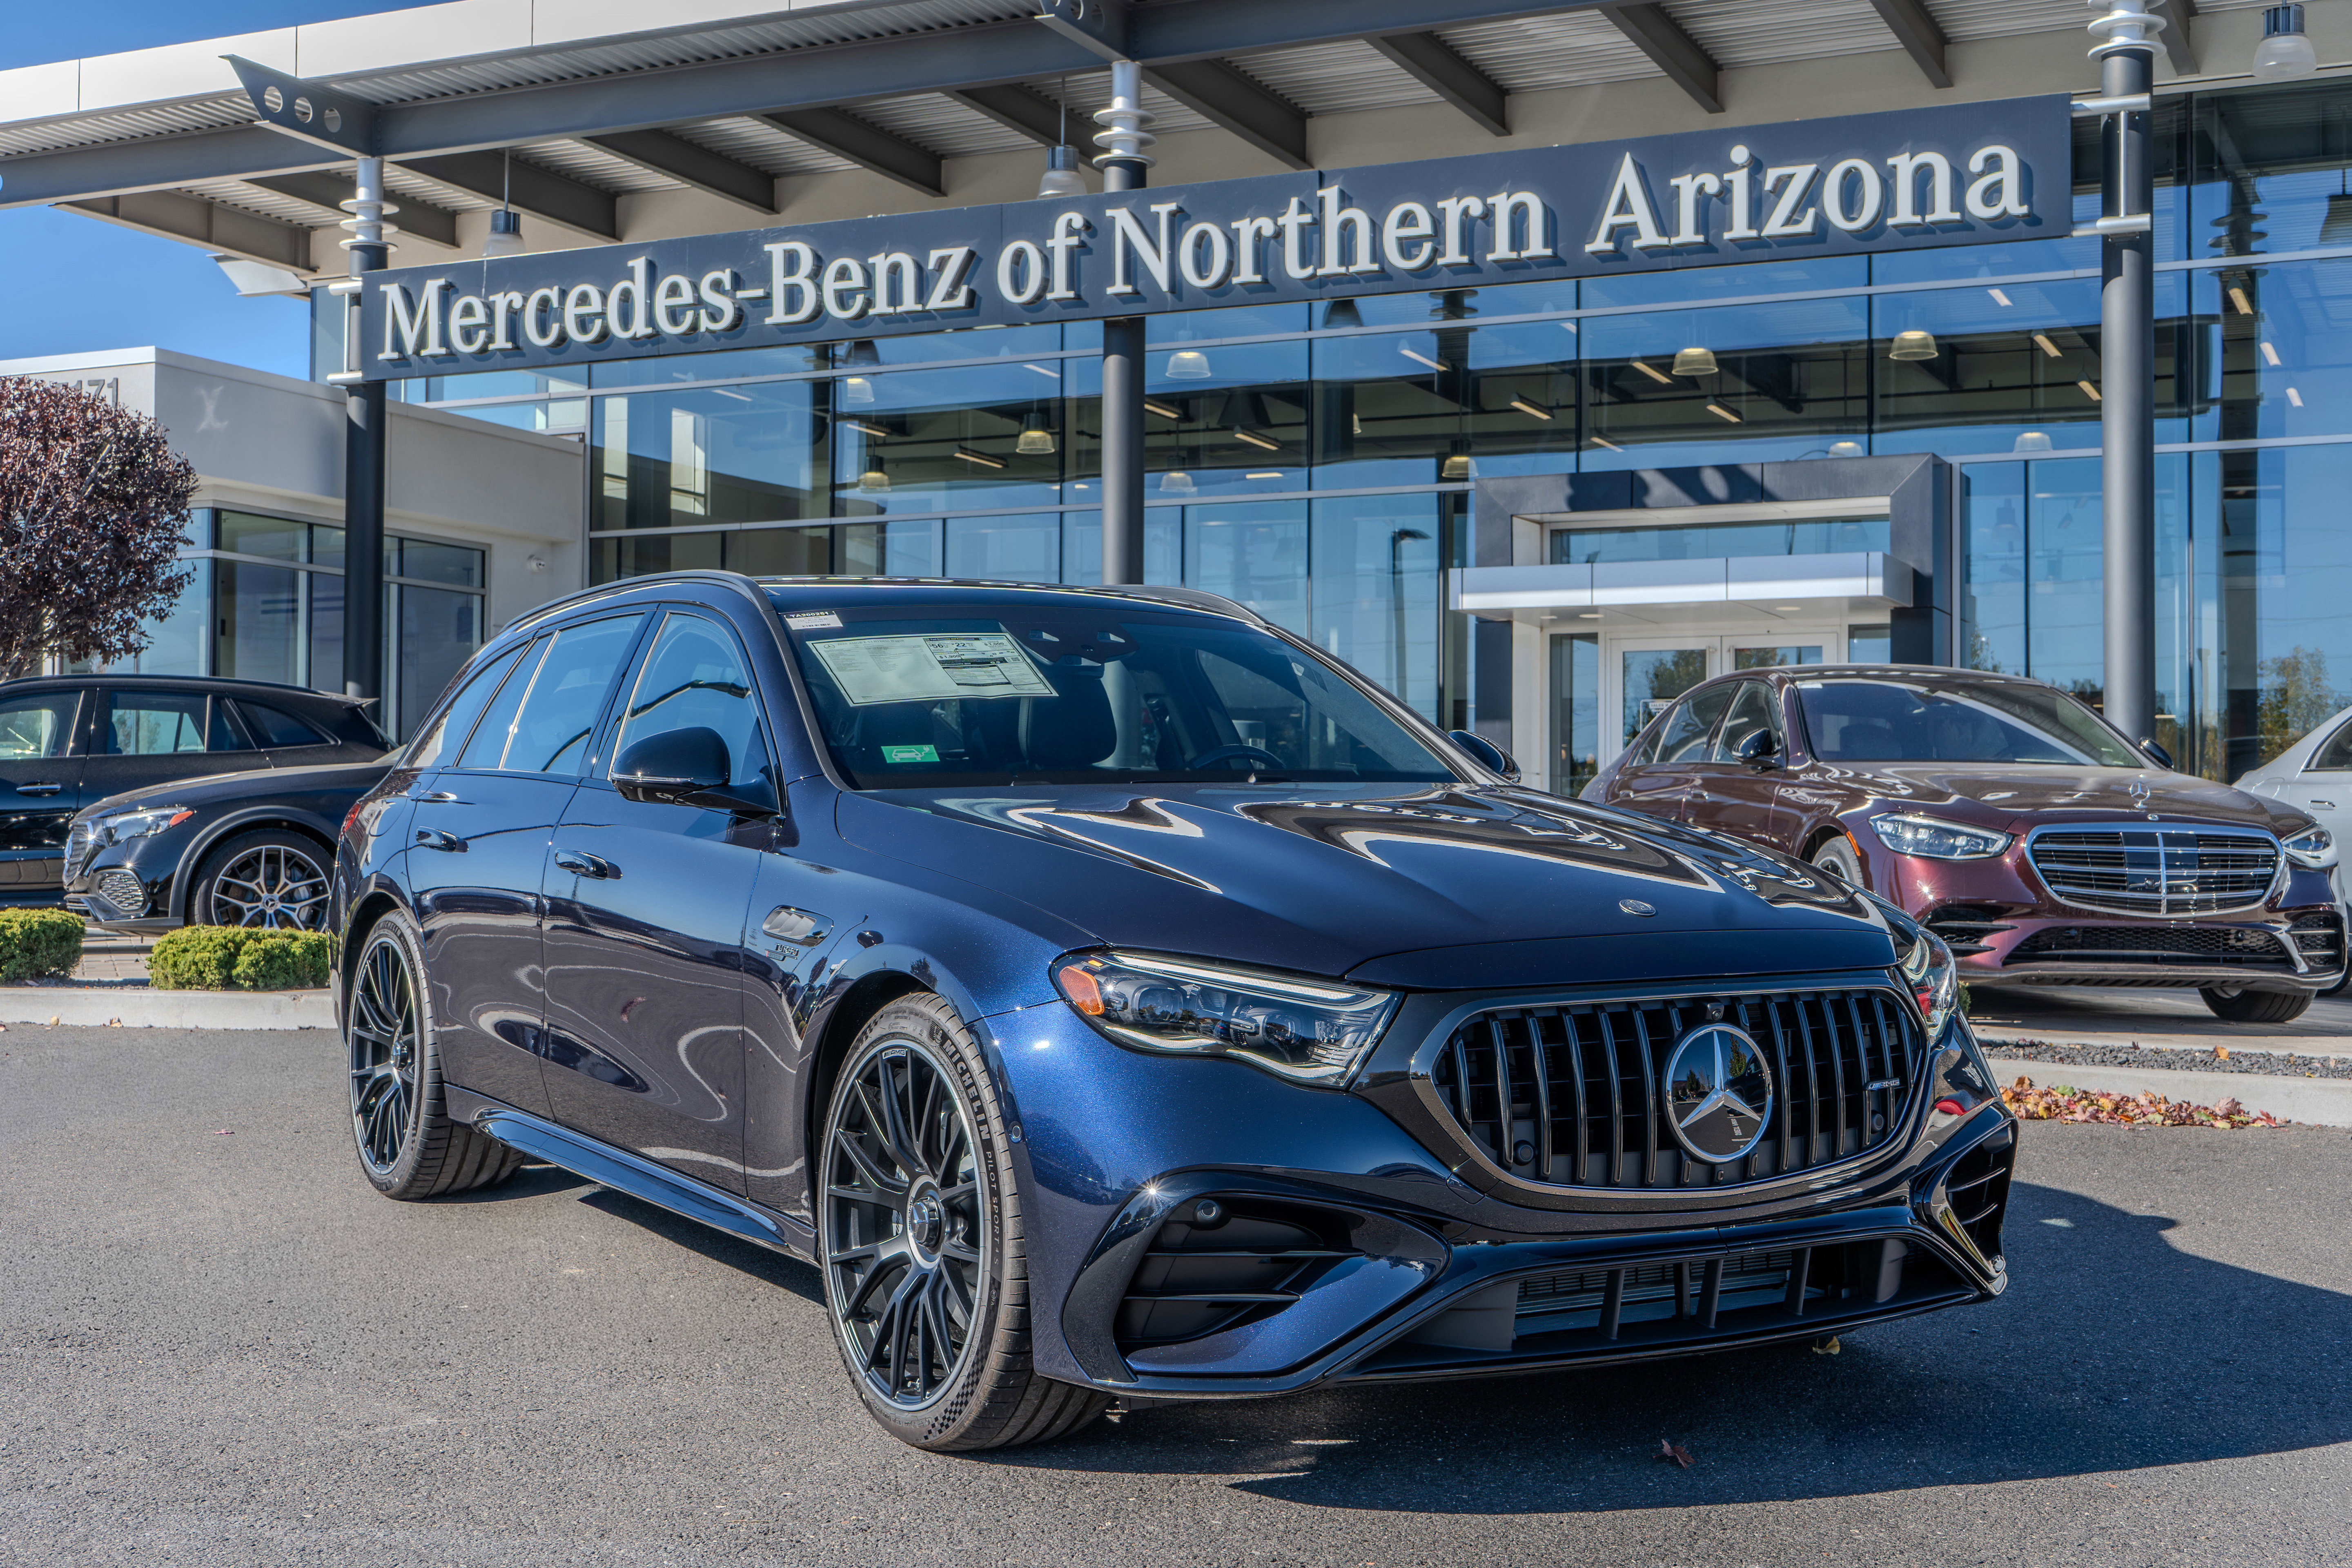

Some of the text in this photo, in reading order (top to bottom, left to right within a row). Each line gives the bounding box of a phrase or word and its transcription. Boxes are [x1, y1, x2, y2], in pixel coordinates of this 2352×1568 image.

[377, 144, 2029, 360] Mercedes-Benz of Northern Arizona
[943, 1039, 991, 1140] MICHELIN
[986, 1152, 996, 1190] PILOT
